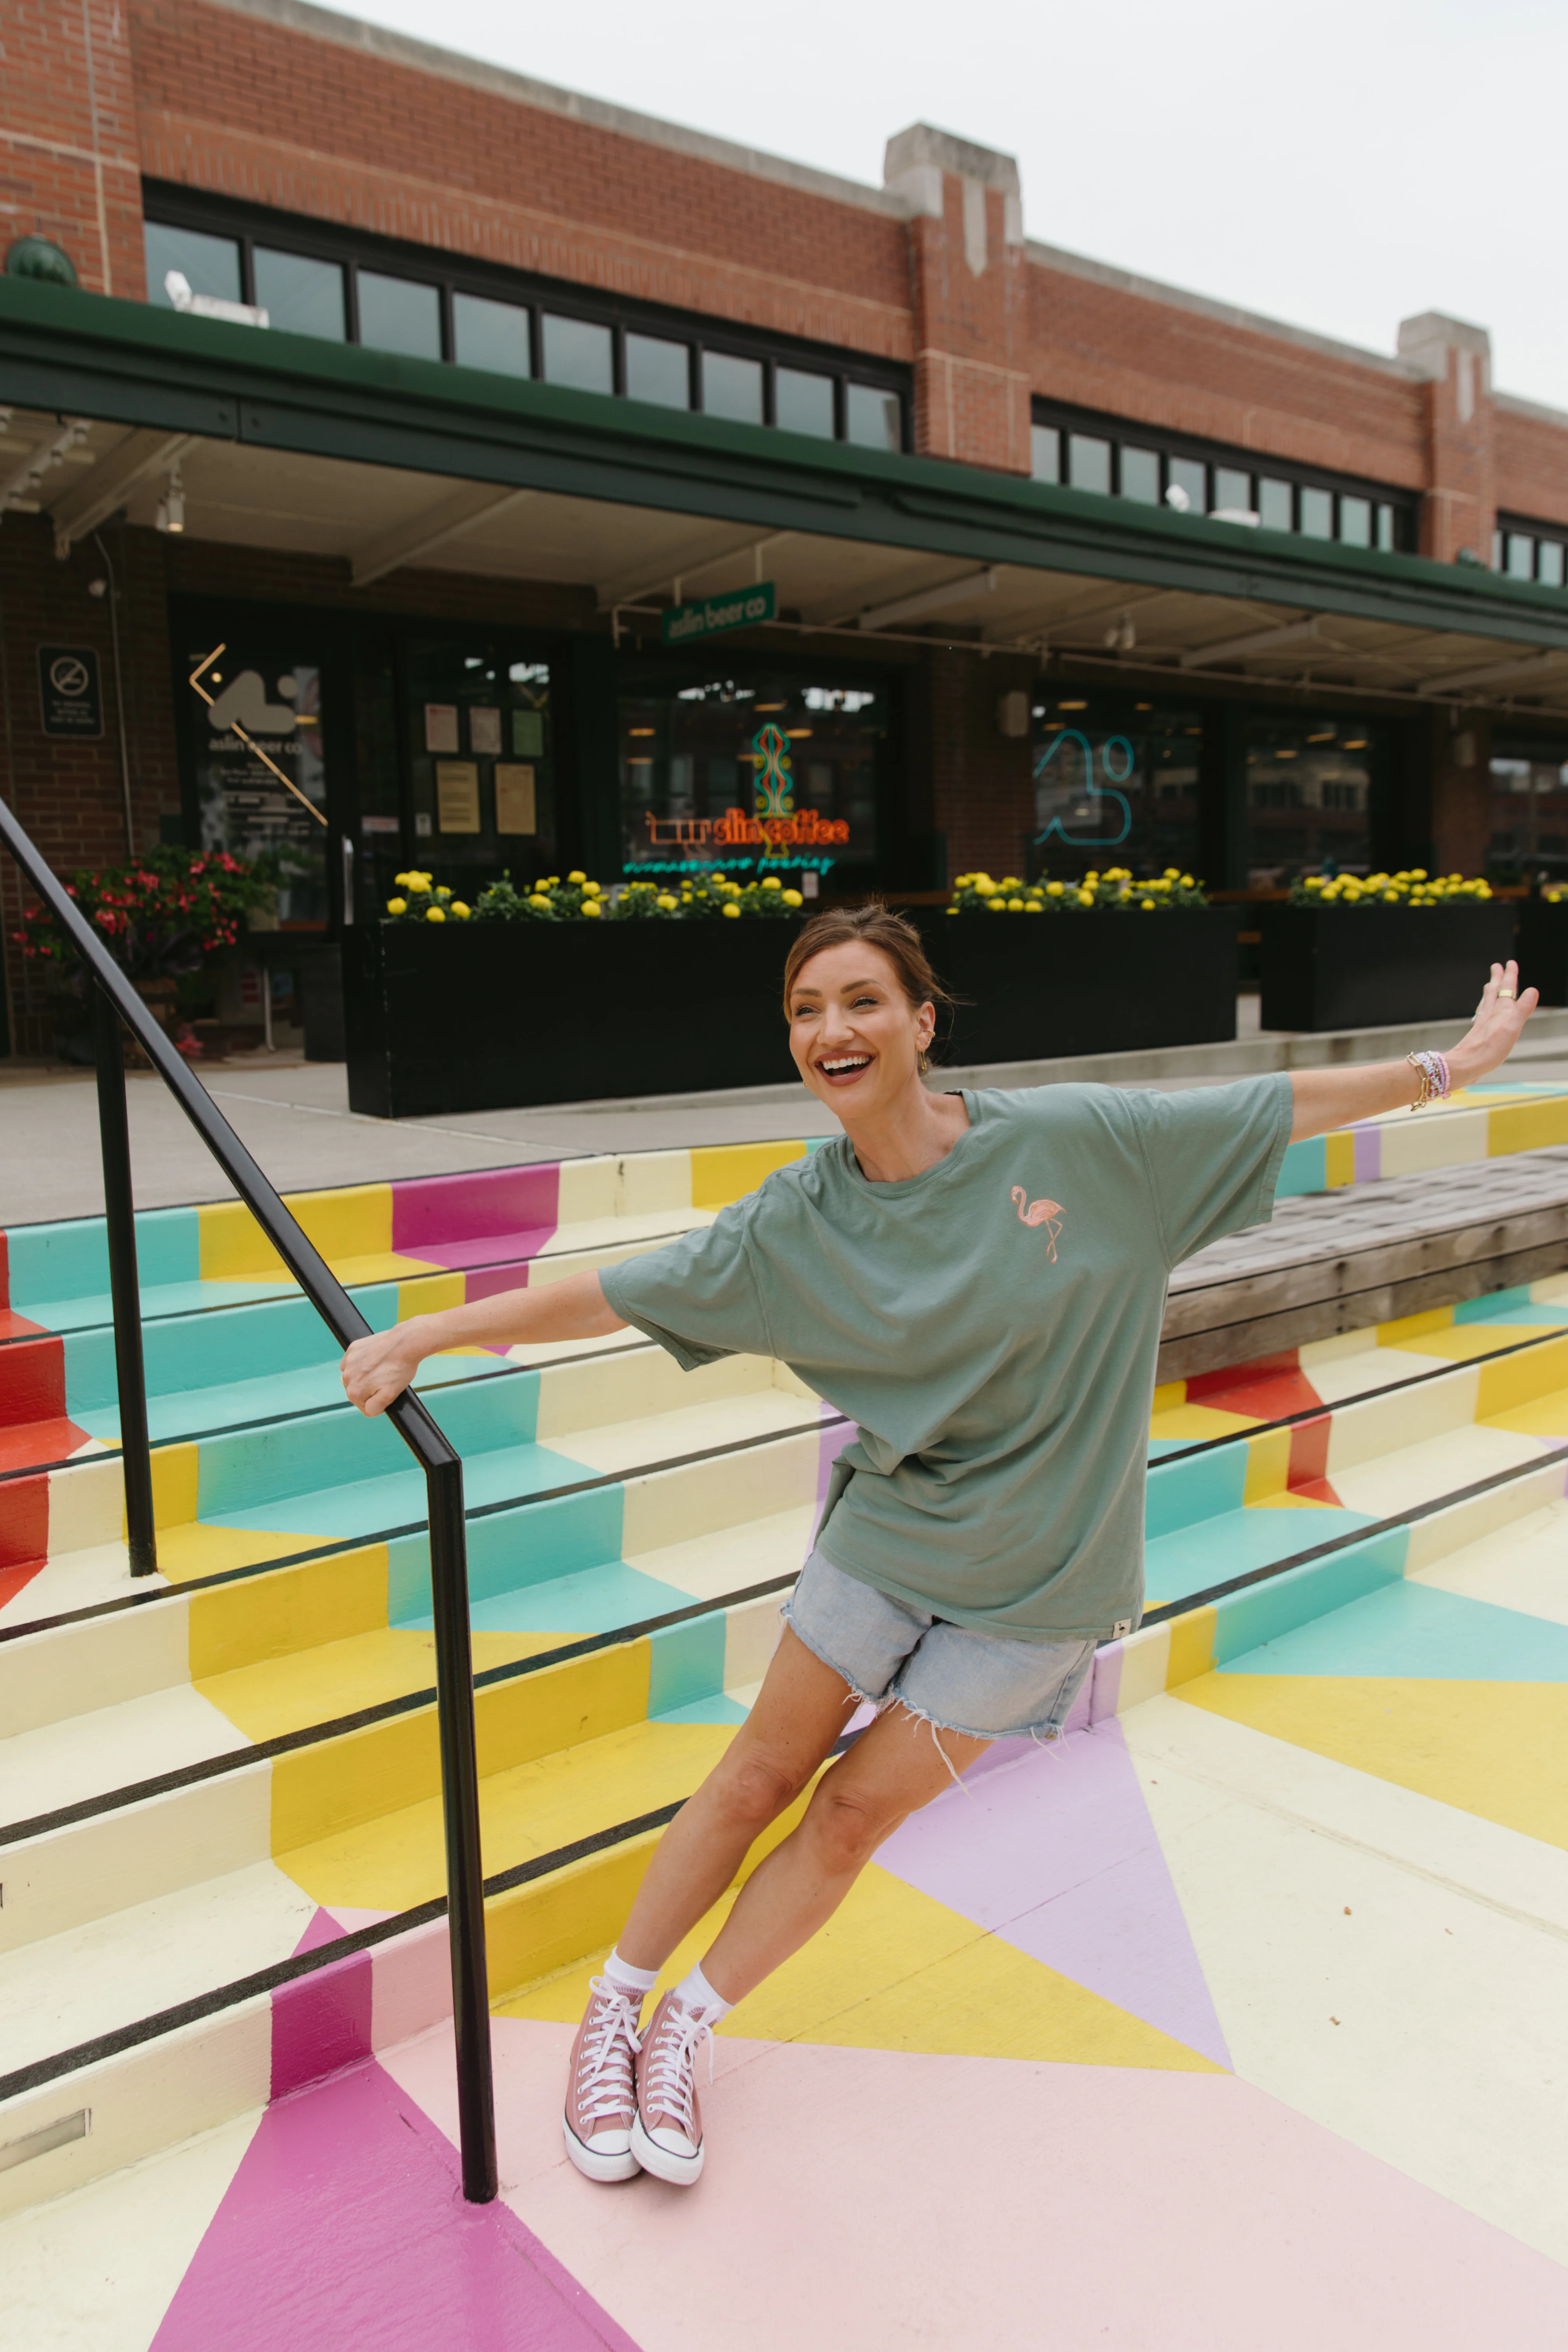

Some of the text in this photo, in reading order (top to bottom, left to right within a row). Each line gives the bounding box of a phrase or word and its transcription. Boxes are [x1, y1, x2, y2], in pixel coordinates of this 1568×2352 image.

[668, 596, 766, 639] aslin beer co
[208, 734, 245, 752] aslin
[284, 741, 303, 755] co
